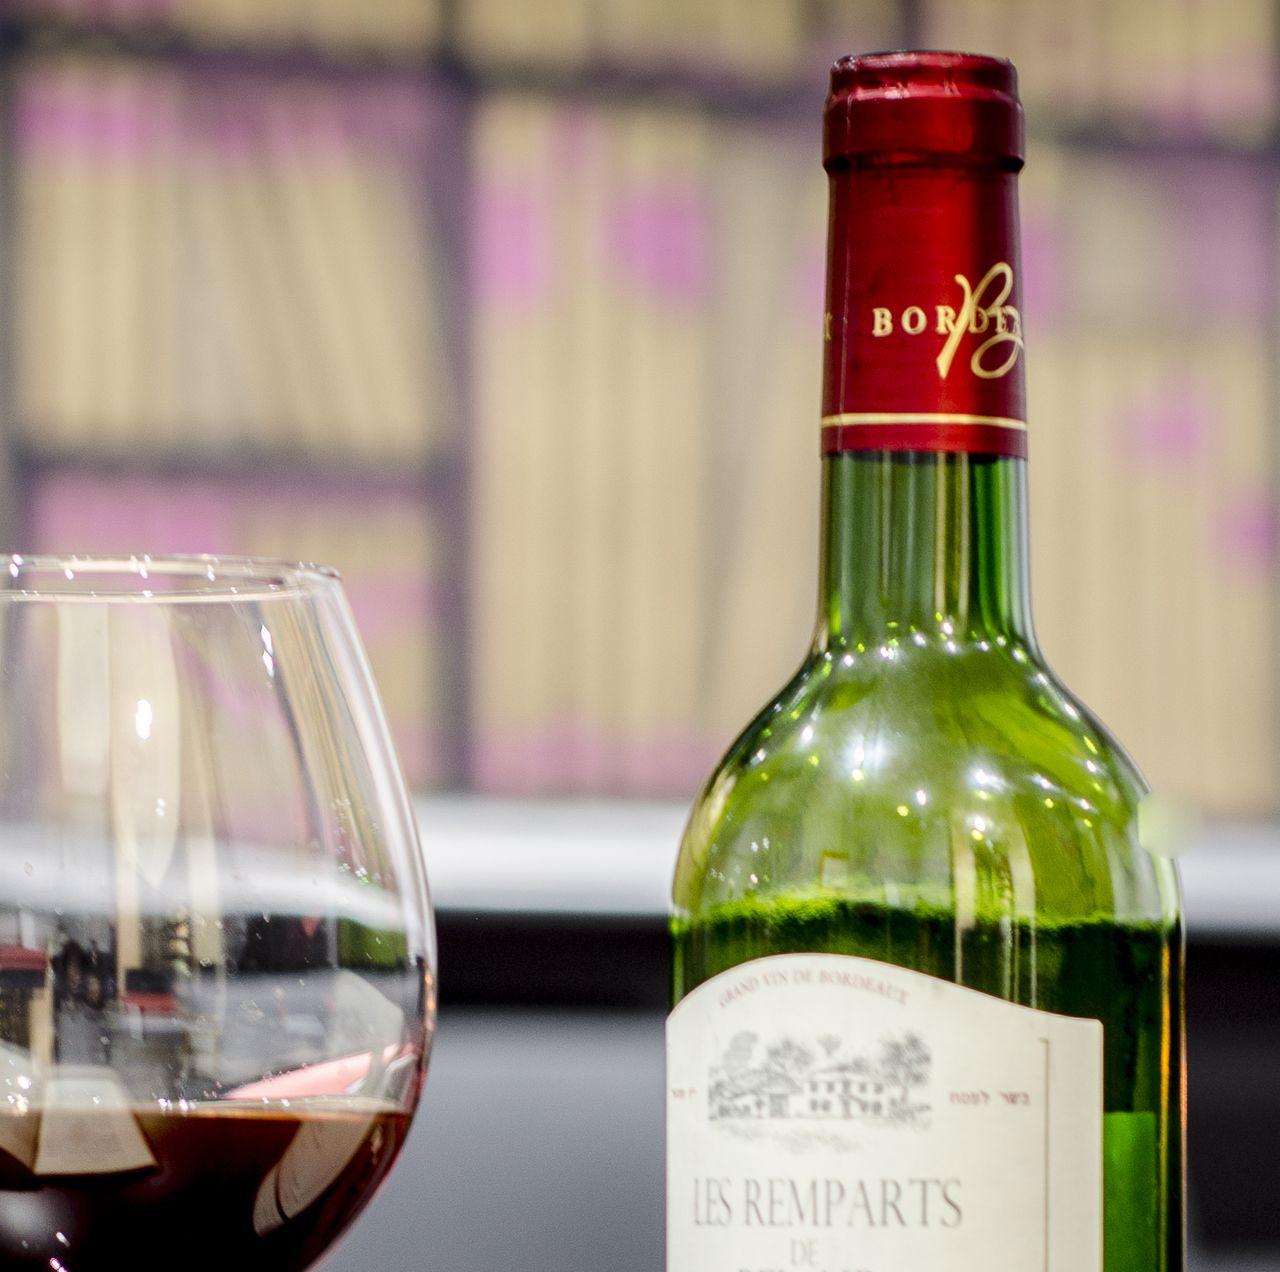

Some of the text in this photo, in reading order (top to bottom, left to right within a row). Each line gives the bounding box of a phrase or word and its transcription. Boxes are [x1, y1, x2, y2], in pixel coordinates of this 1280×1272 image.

[718, 968, 909, 1008] GRAND VIN DE BORDEAUX
[693, 1177, 964, 1229] LES REMPARTS
[790, 1238, 819, 1267] DE
